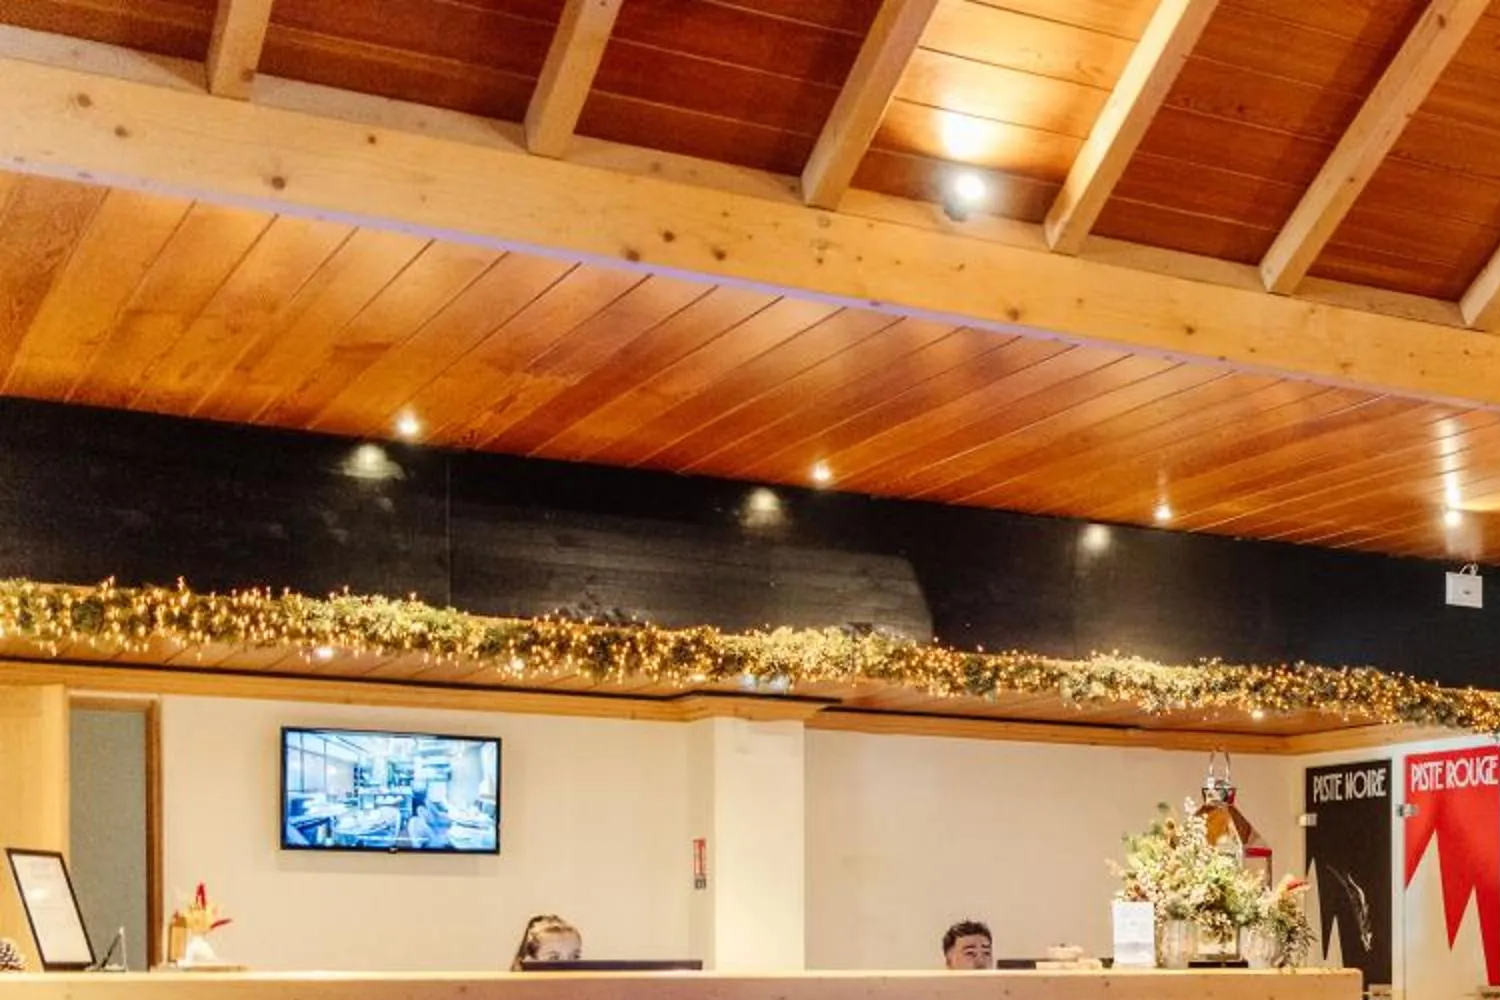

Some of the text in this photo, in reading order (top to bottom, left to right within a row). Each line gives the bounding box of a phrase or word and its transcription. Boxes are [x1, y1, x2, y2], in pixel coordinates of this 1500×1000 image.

[1313, 768, 1387, 804] PISTE NOIRE
[1410, 755, 1499, 793] PISTE ROUGE
